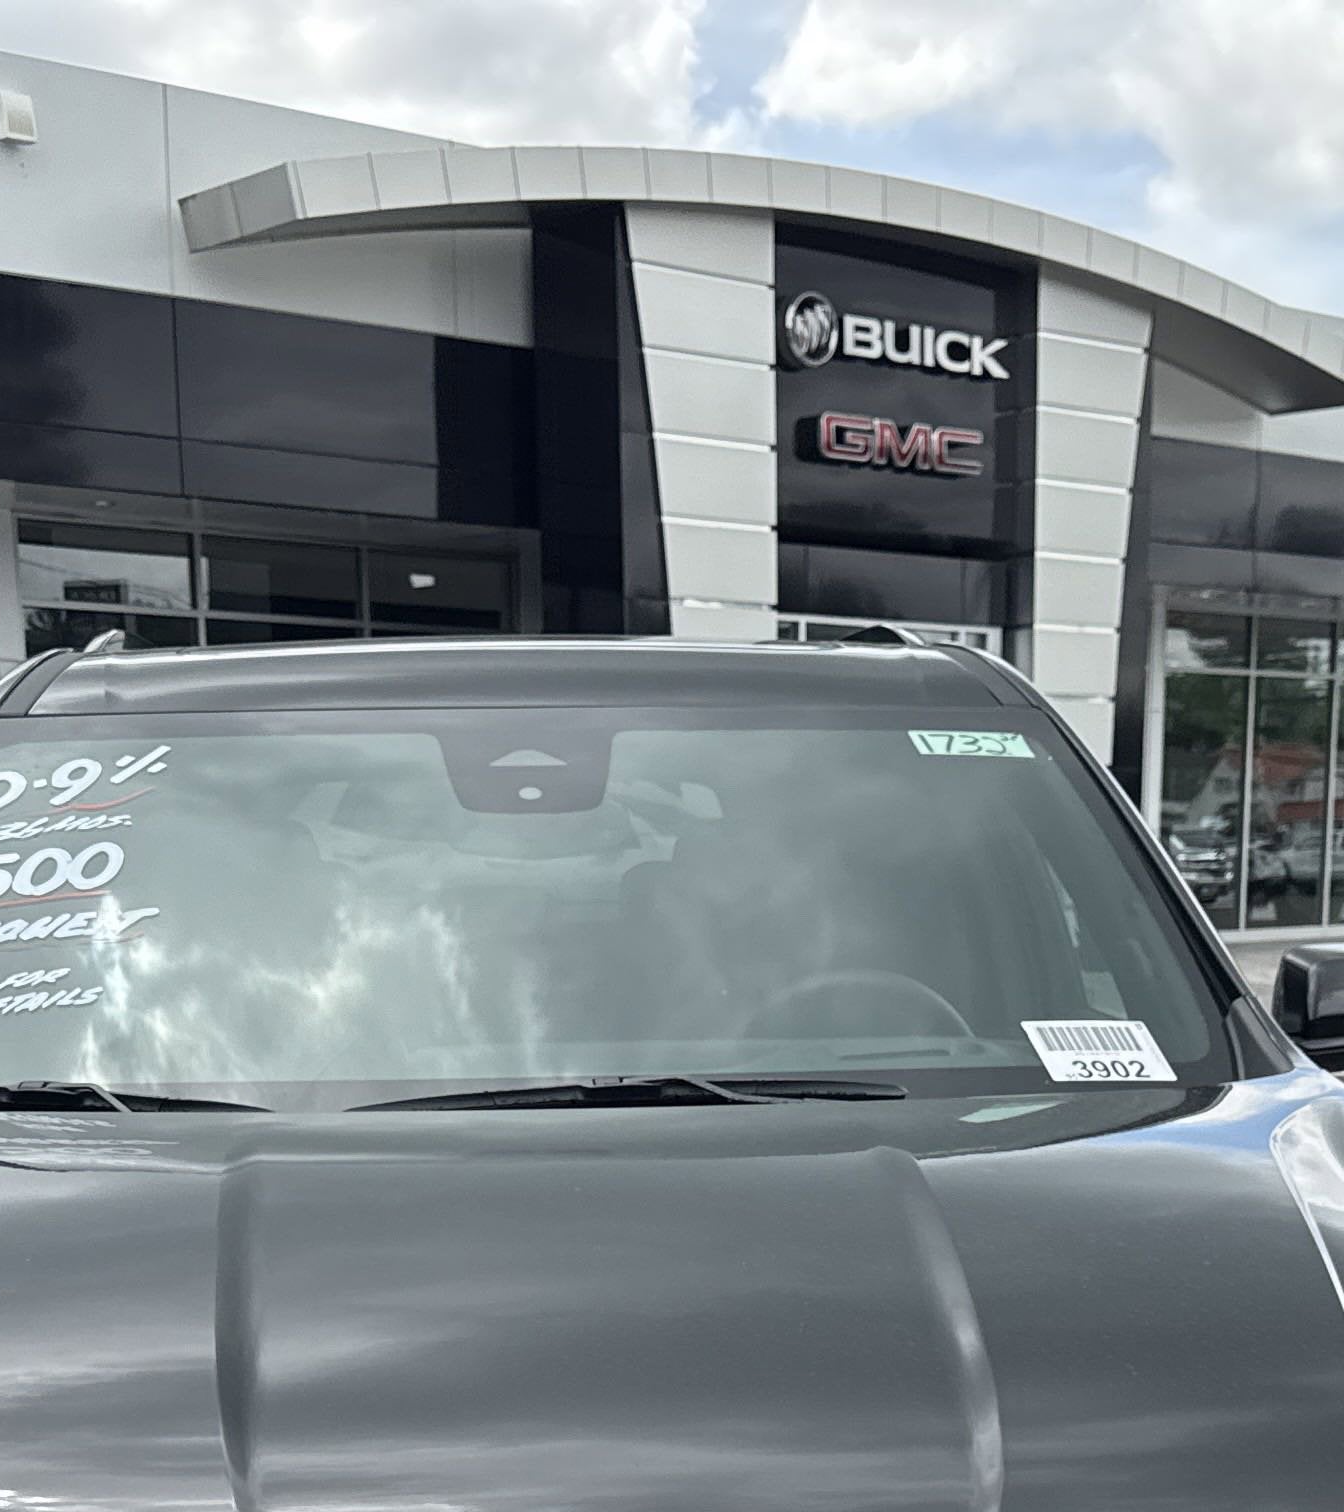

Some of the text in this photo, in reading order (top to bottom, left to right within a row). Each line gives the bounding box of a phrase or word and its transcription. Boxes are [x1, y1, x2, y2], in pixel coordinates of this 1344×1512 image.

[842, 313, 1010, 380] BUICK
[820, 411, 984, 475] GMC
[1072, 1060, 1151, 1078] 3902
